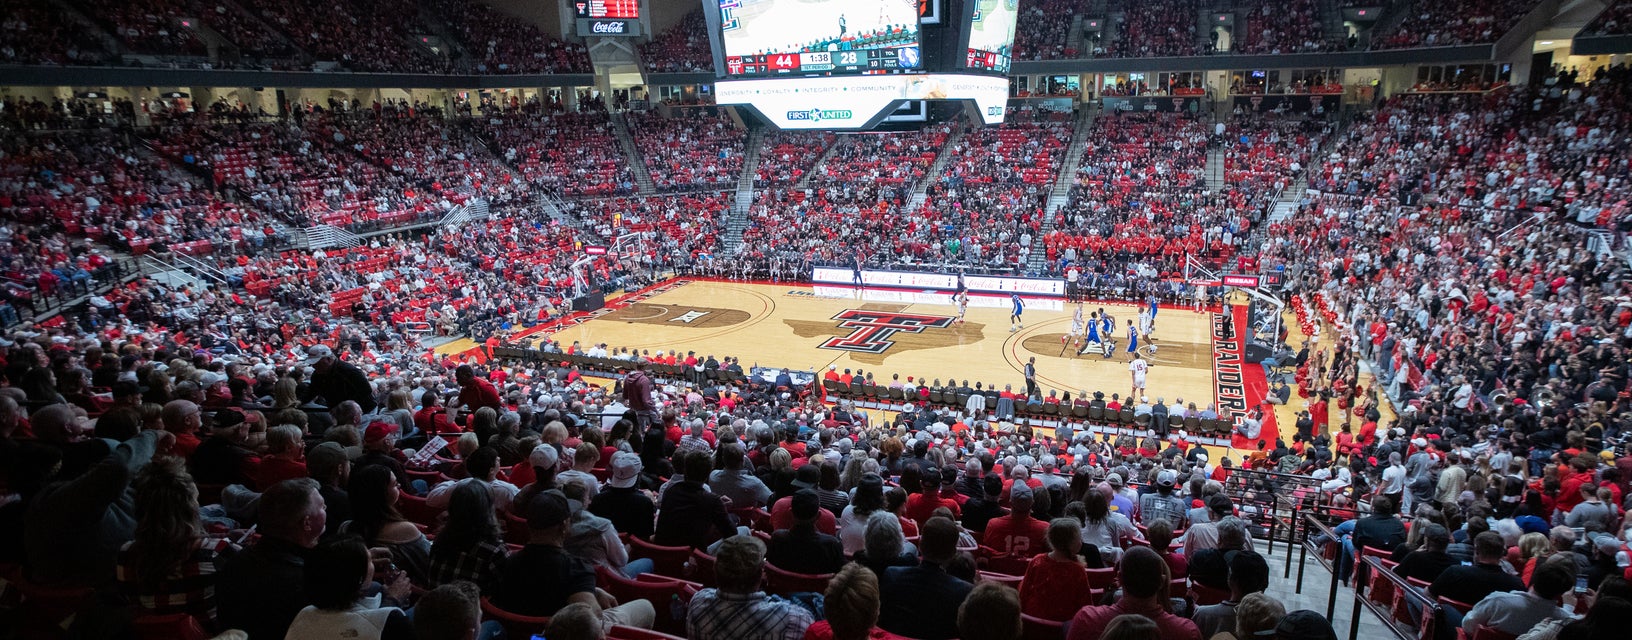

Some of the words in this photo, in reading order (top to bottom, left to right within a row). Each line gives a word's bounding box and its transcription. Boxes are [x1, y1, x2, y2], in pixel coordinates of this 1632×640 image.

[593, 21, 624, 33] Coca-Cola
[775, 55, 793, 67] 44
[809, 54, 829, 62] 1:38
[840, 52, 857, 64] 28
[801, 86, 839, 94] INTEGRITY
[850, 84, 897, 93] COMMUNITY
[788, 111, 809, 120] FIRST
[821, 110, 851, 119] UNITED
[1226, 277, 1255, 285] NISSAN
[1004, 535, 1030, 557] 12
